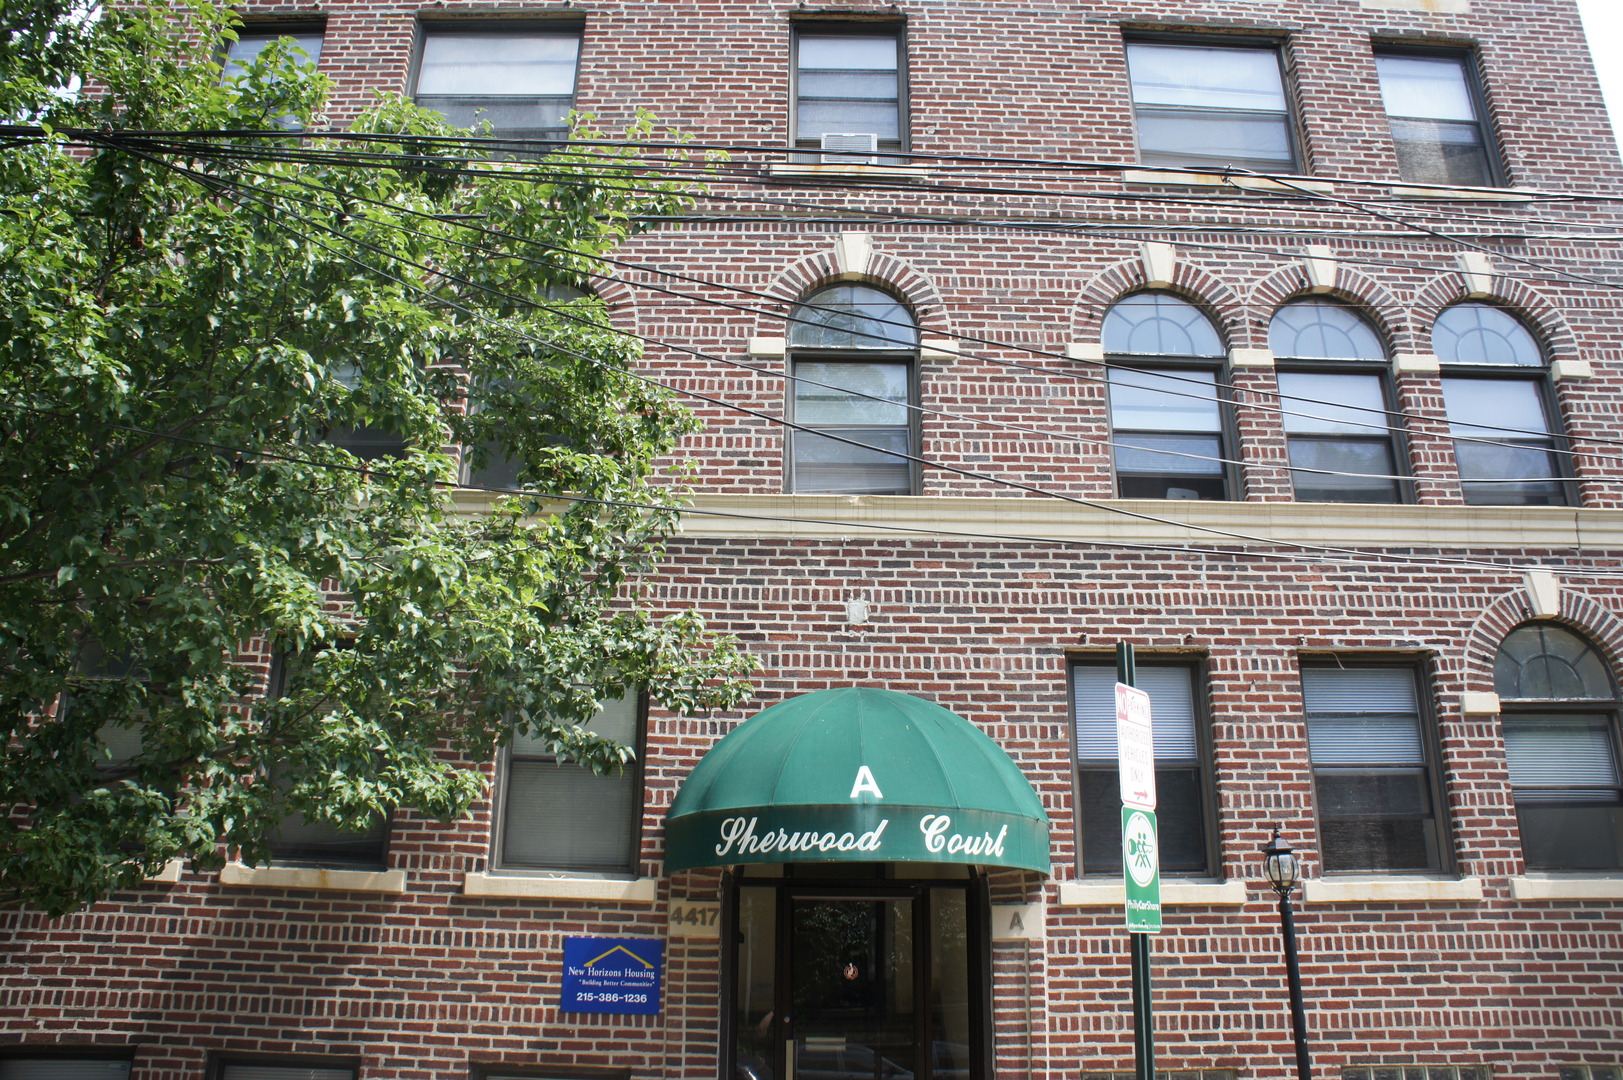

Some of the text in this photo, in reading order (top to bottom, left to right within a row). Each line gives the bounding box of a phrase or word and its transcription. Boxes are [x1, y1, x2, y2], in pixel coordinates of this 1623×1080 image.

[1117, 692, 1148, 719] NO PARKING
[1121, 725, 1149, 746] AUTHORIZED
[1124, 746, 1149, 766] VEHICLES
[850, 765, 883, 799] A
[1130, 767, 1144, 784] ONLY
[715, 814, 1008, 857] Sherwood Court
[670, 906, 720, 928] 4417
[1009, 911, 1025, 931] A
[568, 966, 655, 980] New Horizons Housing
[576, 992, 648, 1003] 215-386-1236
